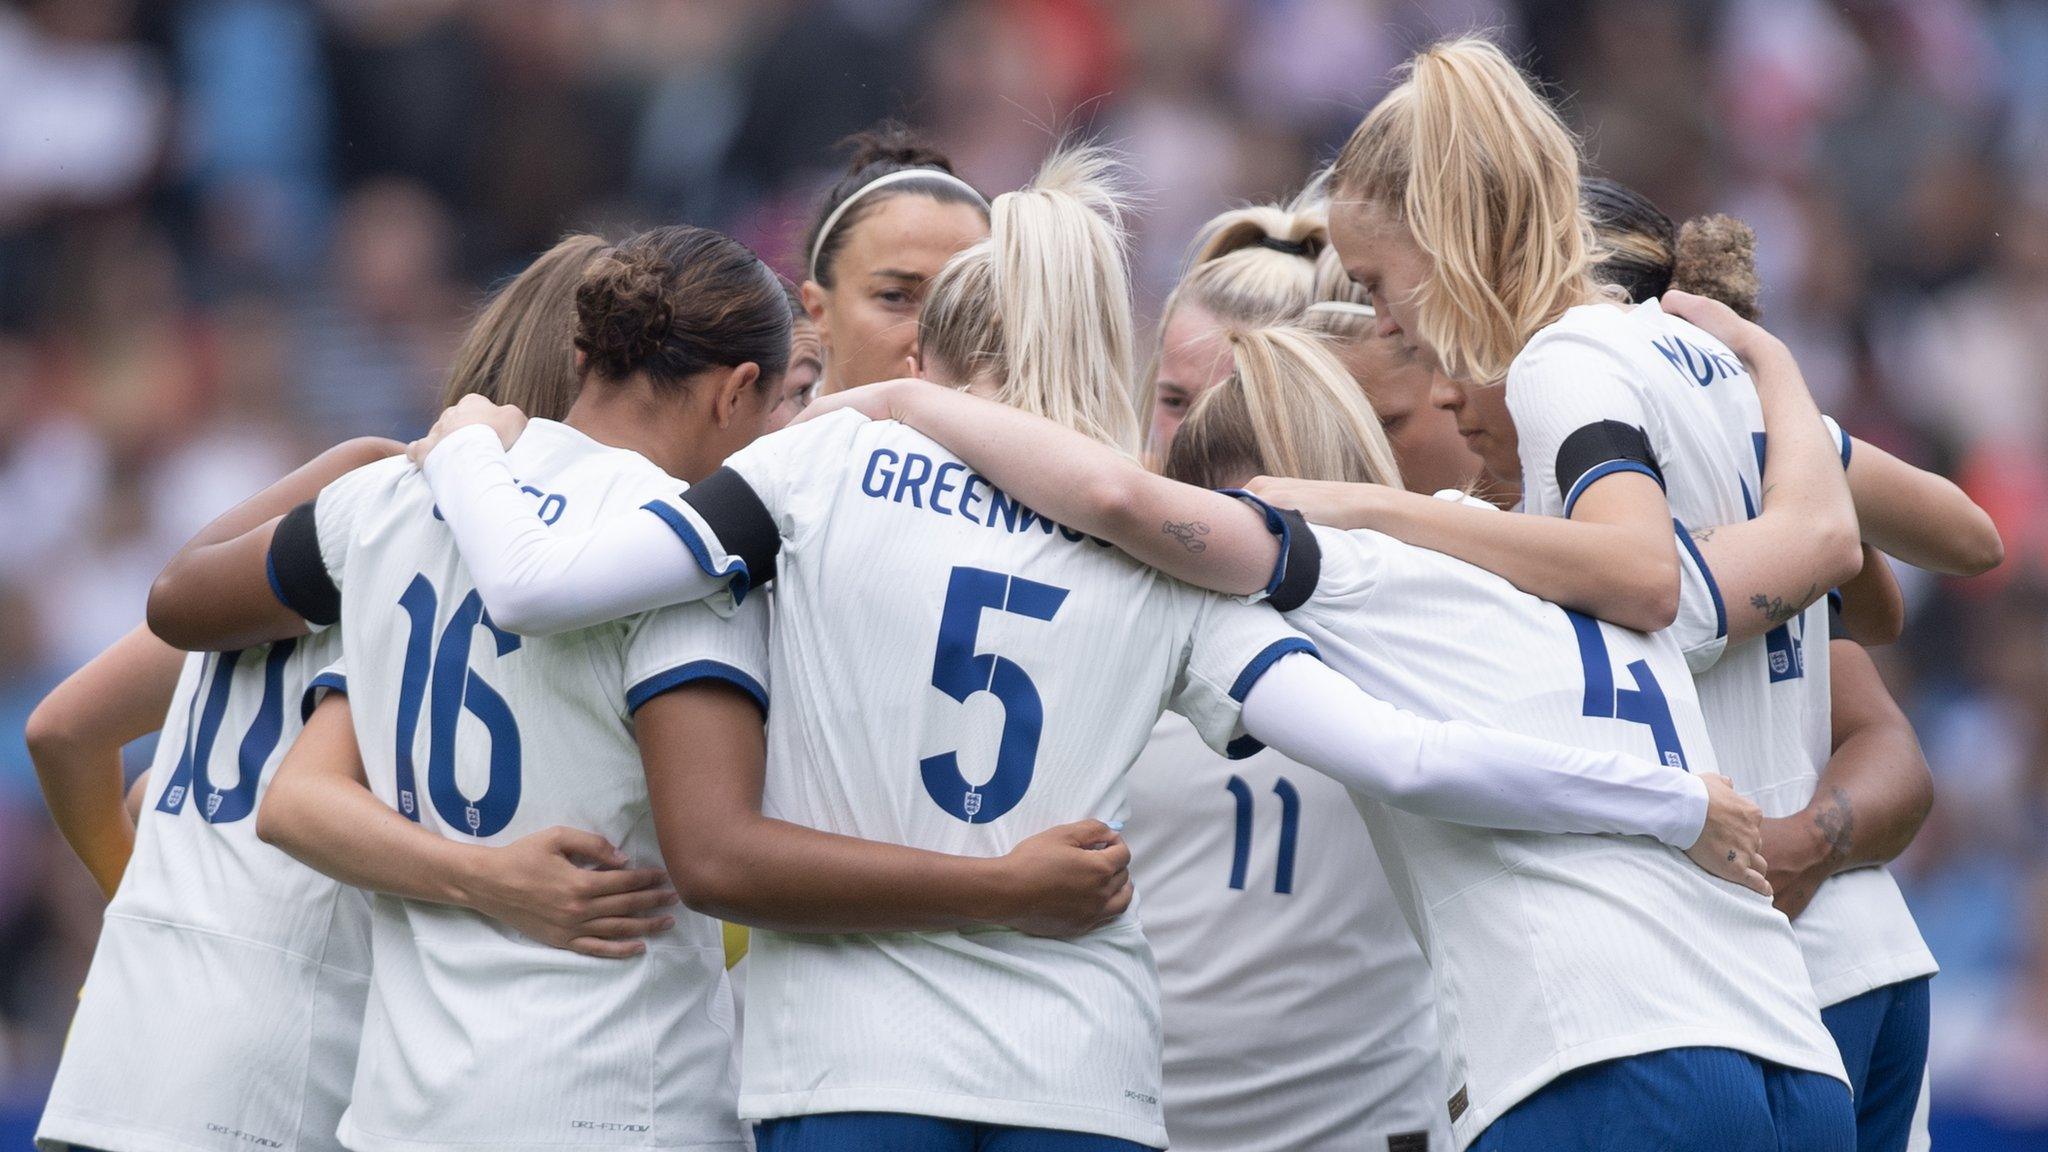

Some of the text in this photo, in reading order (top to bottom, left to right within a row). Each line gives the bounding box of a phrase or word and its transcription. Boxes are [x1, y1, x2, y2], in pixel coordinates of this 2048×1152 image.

[155, 636, 298, 825] 10
[396, 571, 522, 838] 16
[920, 566, 1071, 824] 5
[1565, 608, 1690, 773] 4
[1225, 773, 1302, 894] 11
